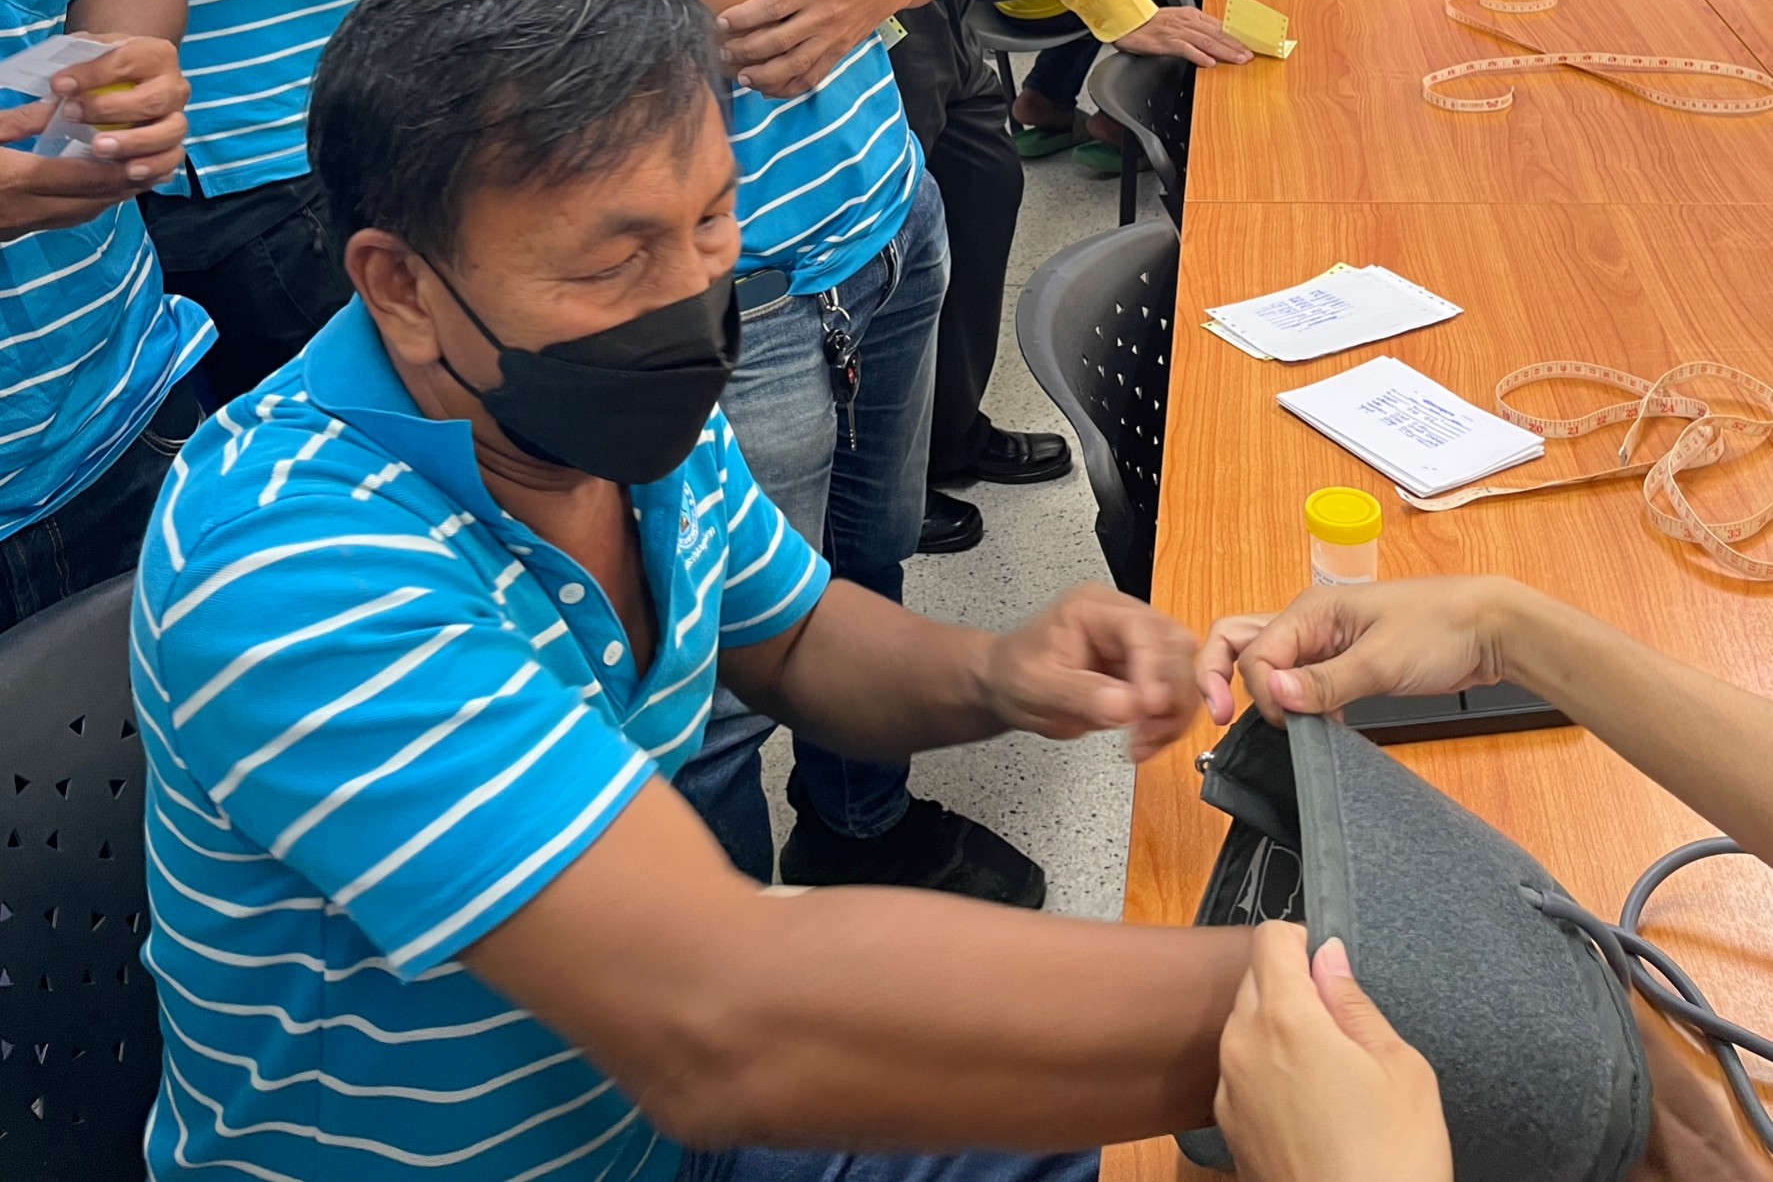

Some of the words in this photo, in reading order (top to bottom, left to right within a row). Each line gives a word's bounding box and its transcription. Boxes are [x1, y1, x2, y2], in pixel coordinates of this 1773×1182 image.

[1529, 423, 1543, 434] 20
[1567, 426, 1579, 435] 21
[1597, 415, 1607, 426] 22
[1626, 408, 1638, 418] 23
[1660, 404, 1675, 413] 24
[1728, 529, 1741, 539] 33
